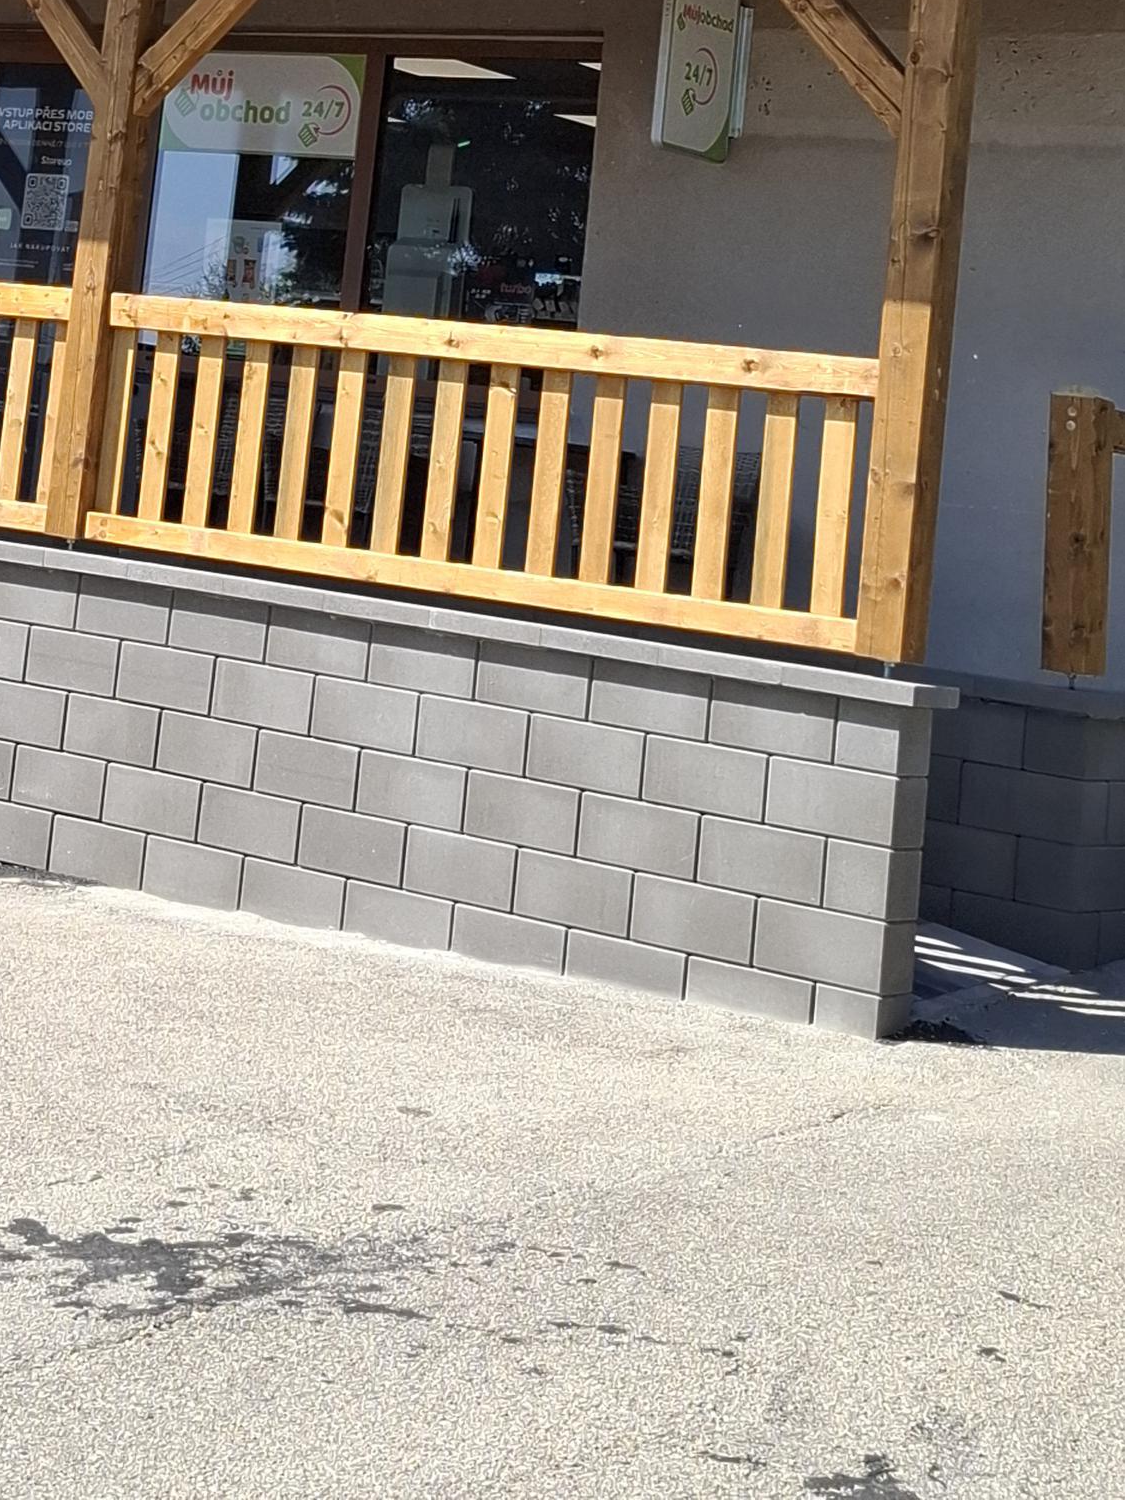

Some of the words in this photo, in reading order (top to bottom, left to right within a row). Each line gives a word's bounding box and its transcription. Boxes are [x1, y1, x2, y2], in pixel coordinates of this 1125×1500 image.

[190, 70, 234, 100] Můj
[684, 62, 713, 87] 24/7
[0, 107, 34, 118] VSTUP
[35, 106, 65, 119] PŘES
[66, 110, 94, 121] MOB
[199, 100, 291, 124] obchod
[301, 100, 345, 120] 24/7
[53, 121, 92, 134] STORE
